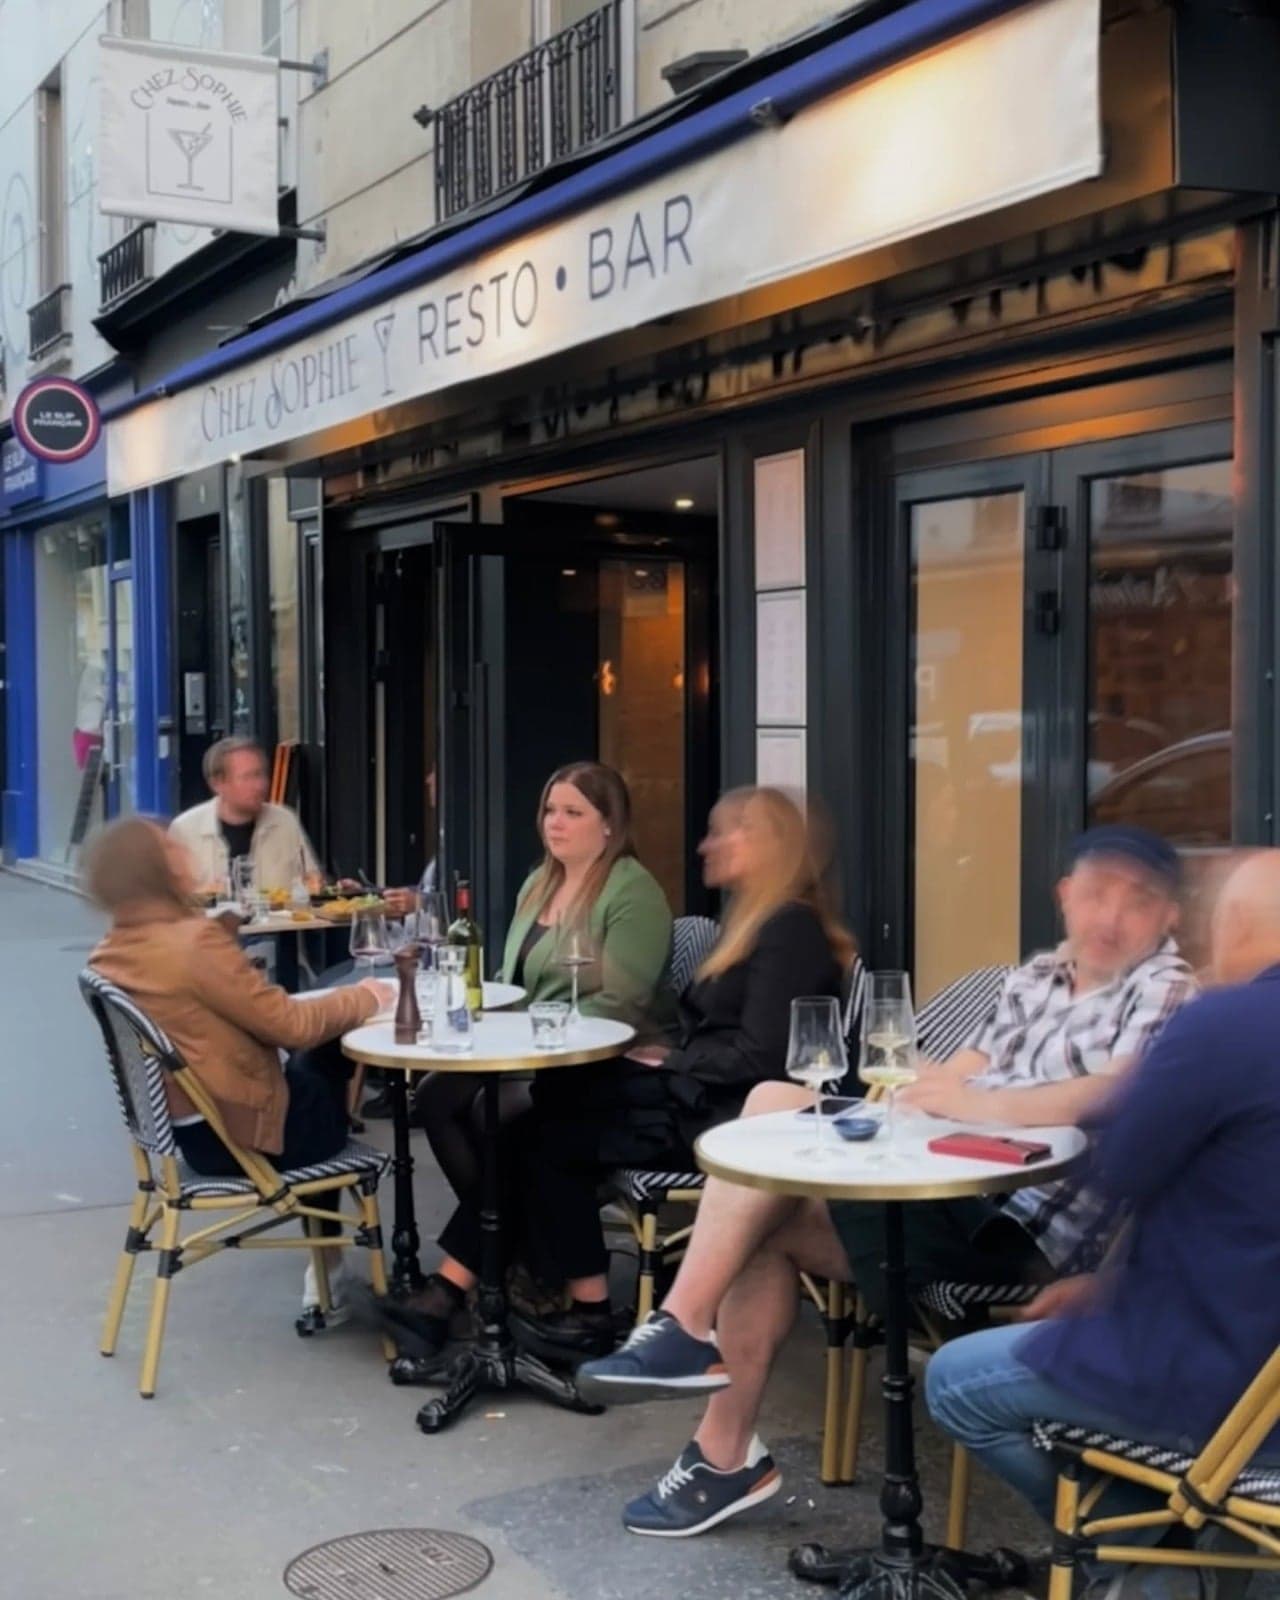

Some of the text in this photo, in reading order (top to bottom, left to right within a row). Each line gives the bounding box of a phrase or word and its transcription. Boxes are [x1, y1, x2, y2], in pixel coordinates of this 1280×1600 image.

[130, 66, 248, 125] CHEZ SOPHIE
[201, 194, 694, 442] CHEZ SOPHIE RESTO BAR
